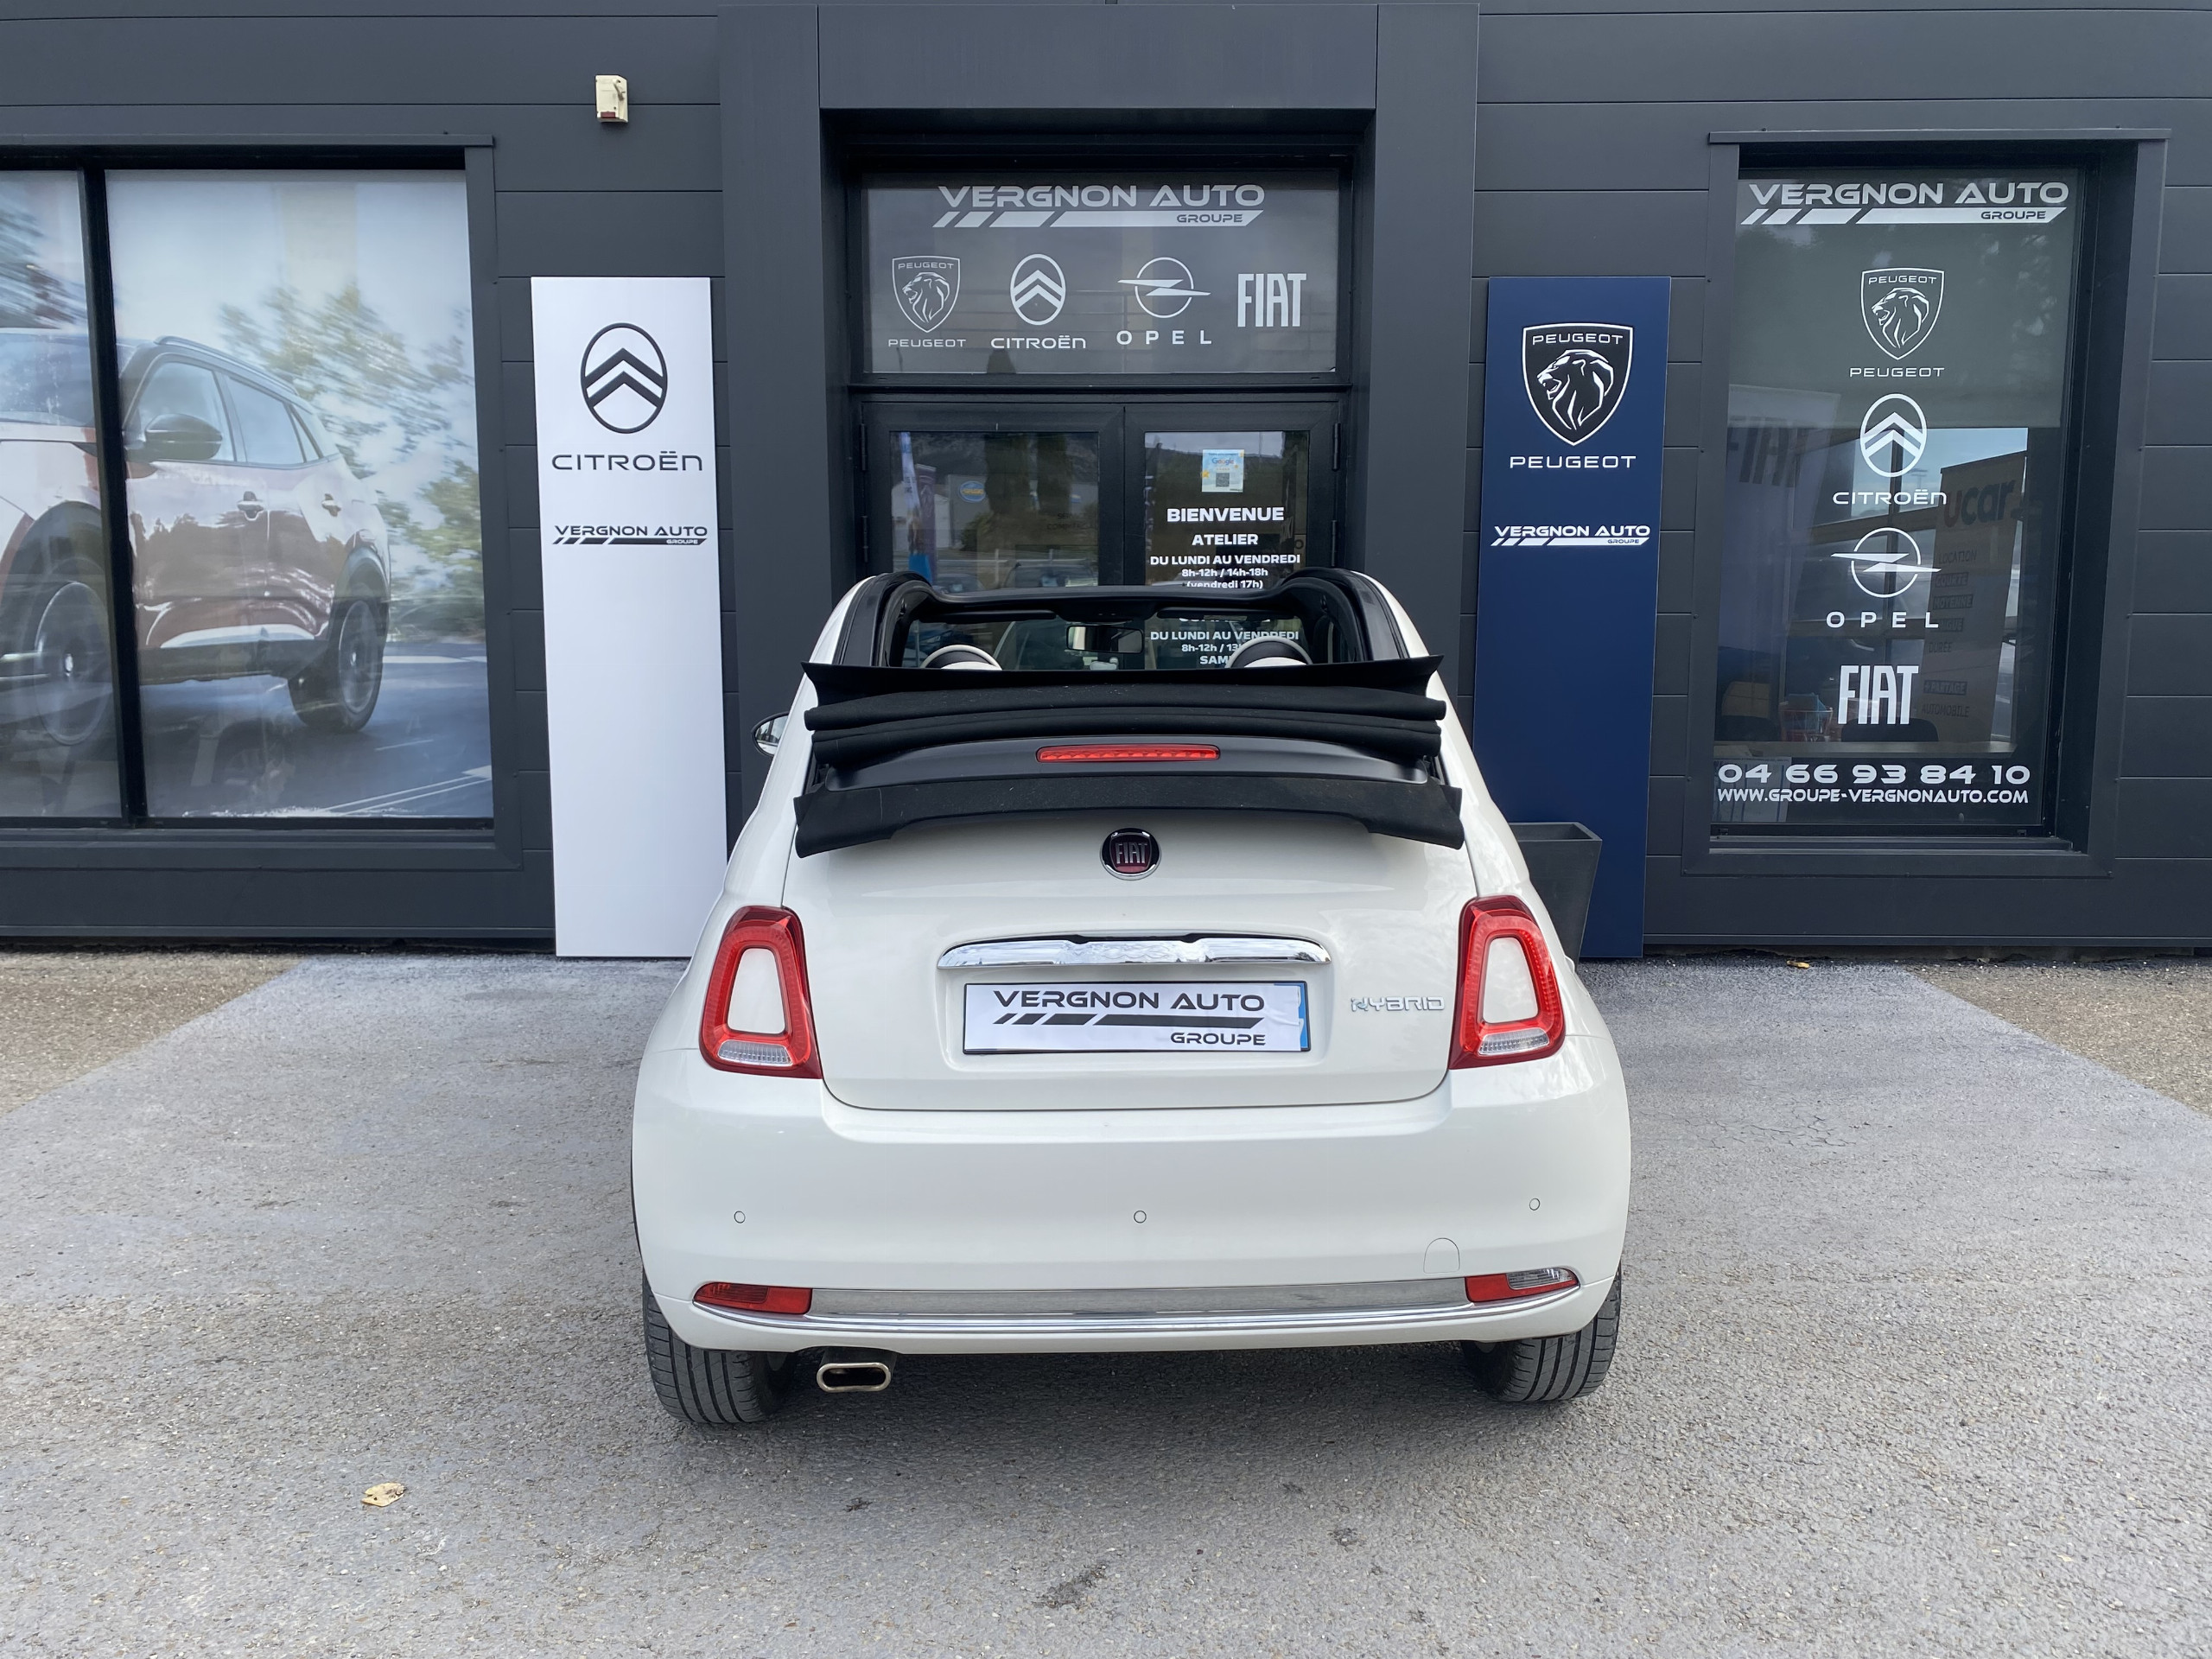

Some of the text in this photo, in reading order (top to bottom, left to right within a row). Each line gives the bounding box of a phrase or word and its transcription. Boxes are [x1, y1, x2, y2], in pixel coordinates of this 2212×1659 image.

[938, 184, 1265, 207] VERGNON AUTO
[1749, 181, 2069, 205] VERGNON AUTO
[1176, 213, 1243, 224] GROUPE
[1980, 211, 2046, 220] GROUPE
[898, 262, 954, 270] PEUGEOT
[1868, 275, 1937, 285] PEUGEOT
[1237, 273, 1307, 327] FIAT
[888, 339, 967, 348] PEUGEOT
[990, 335, 1086, 349] CITROËN
[1116, 330, 1212, 345] OPEL
[1532, 334, 1624, 346] PEUGEOT
[1849, 367, 1945, 378] PEUGEOT
[551, 451, 702, 471] CITROËN
[1510, 455, 1637, 468] PEUGEOT
[1832, 489, 1948, 505] CITROËN
[1166, 506, 1285, 522] BIENVENUE
[554, 525, 708, 537] VERGNON AUTO
[1494, 525, 1651, 537] VERGNON AUTO
[1192, 533, 1259, 546] ATELIER
[1150, 554, 1300, 565] DU LUNDI AU VENDREDI
[1181, 569, 1217, 577] 8h-12h
[1226, 568, 1268, 576] 14h-18h
[1240, 580, 1263, 589] 17h)
[1826, 611, 1939, 628] OPEL
[1150, 632, 1169, 640] DU
[1171, 632, 1210, 640] LUNDI
[1181, 644, 1217, 652] 8h-12h
[1199, 655, 1231, 664] SAM
[1837, 665, 1919, 725] FIAT
[1718, 764, 2031, 785] 04 66 93 84 10
[1717, 788, 2029, 804] WWW.GROUPE-VERGNONAUTO.COM
[1116, 842, 1147, 864] FIAT
[993, 990, 1265, 1012] VERGNON AUTO
[1170, 1032, 1266, 1046] GROUPE
